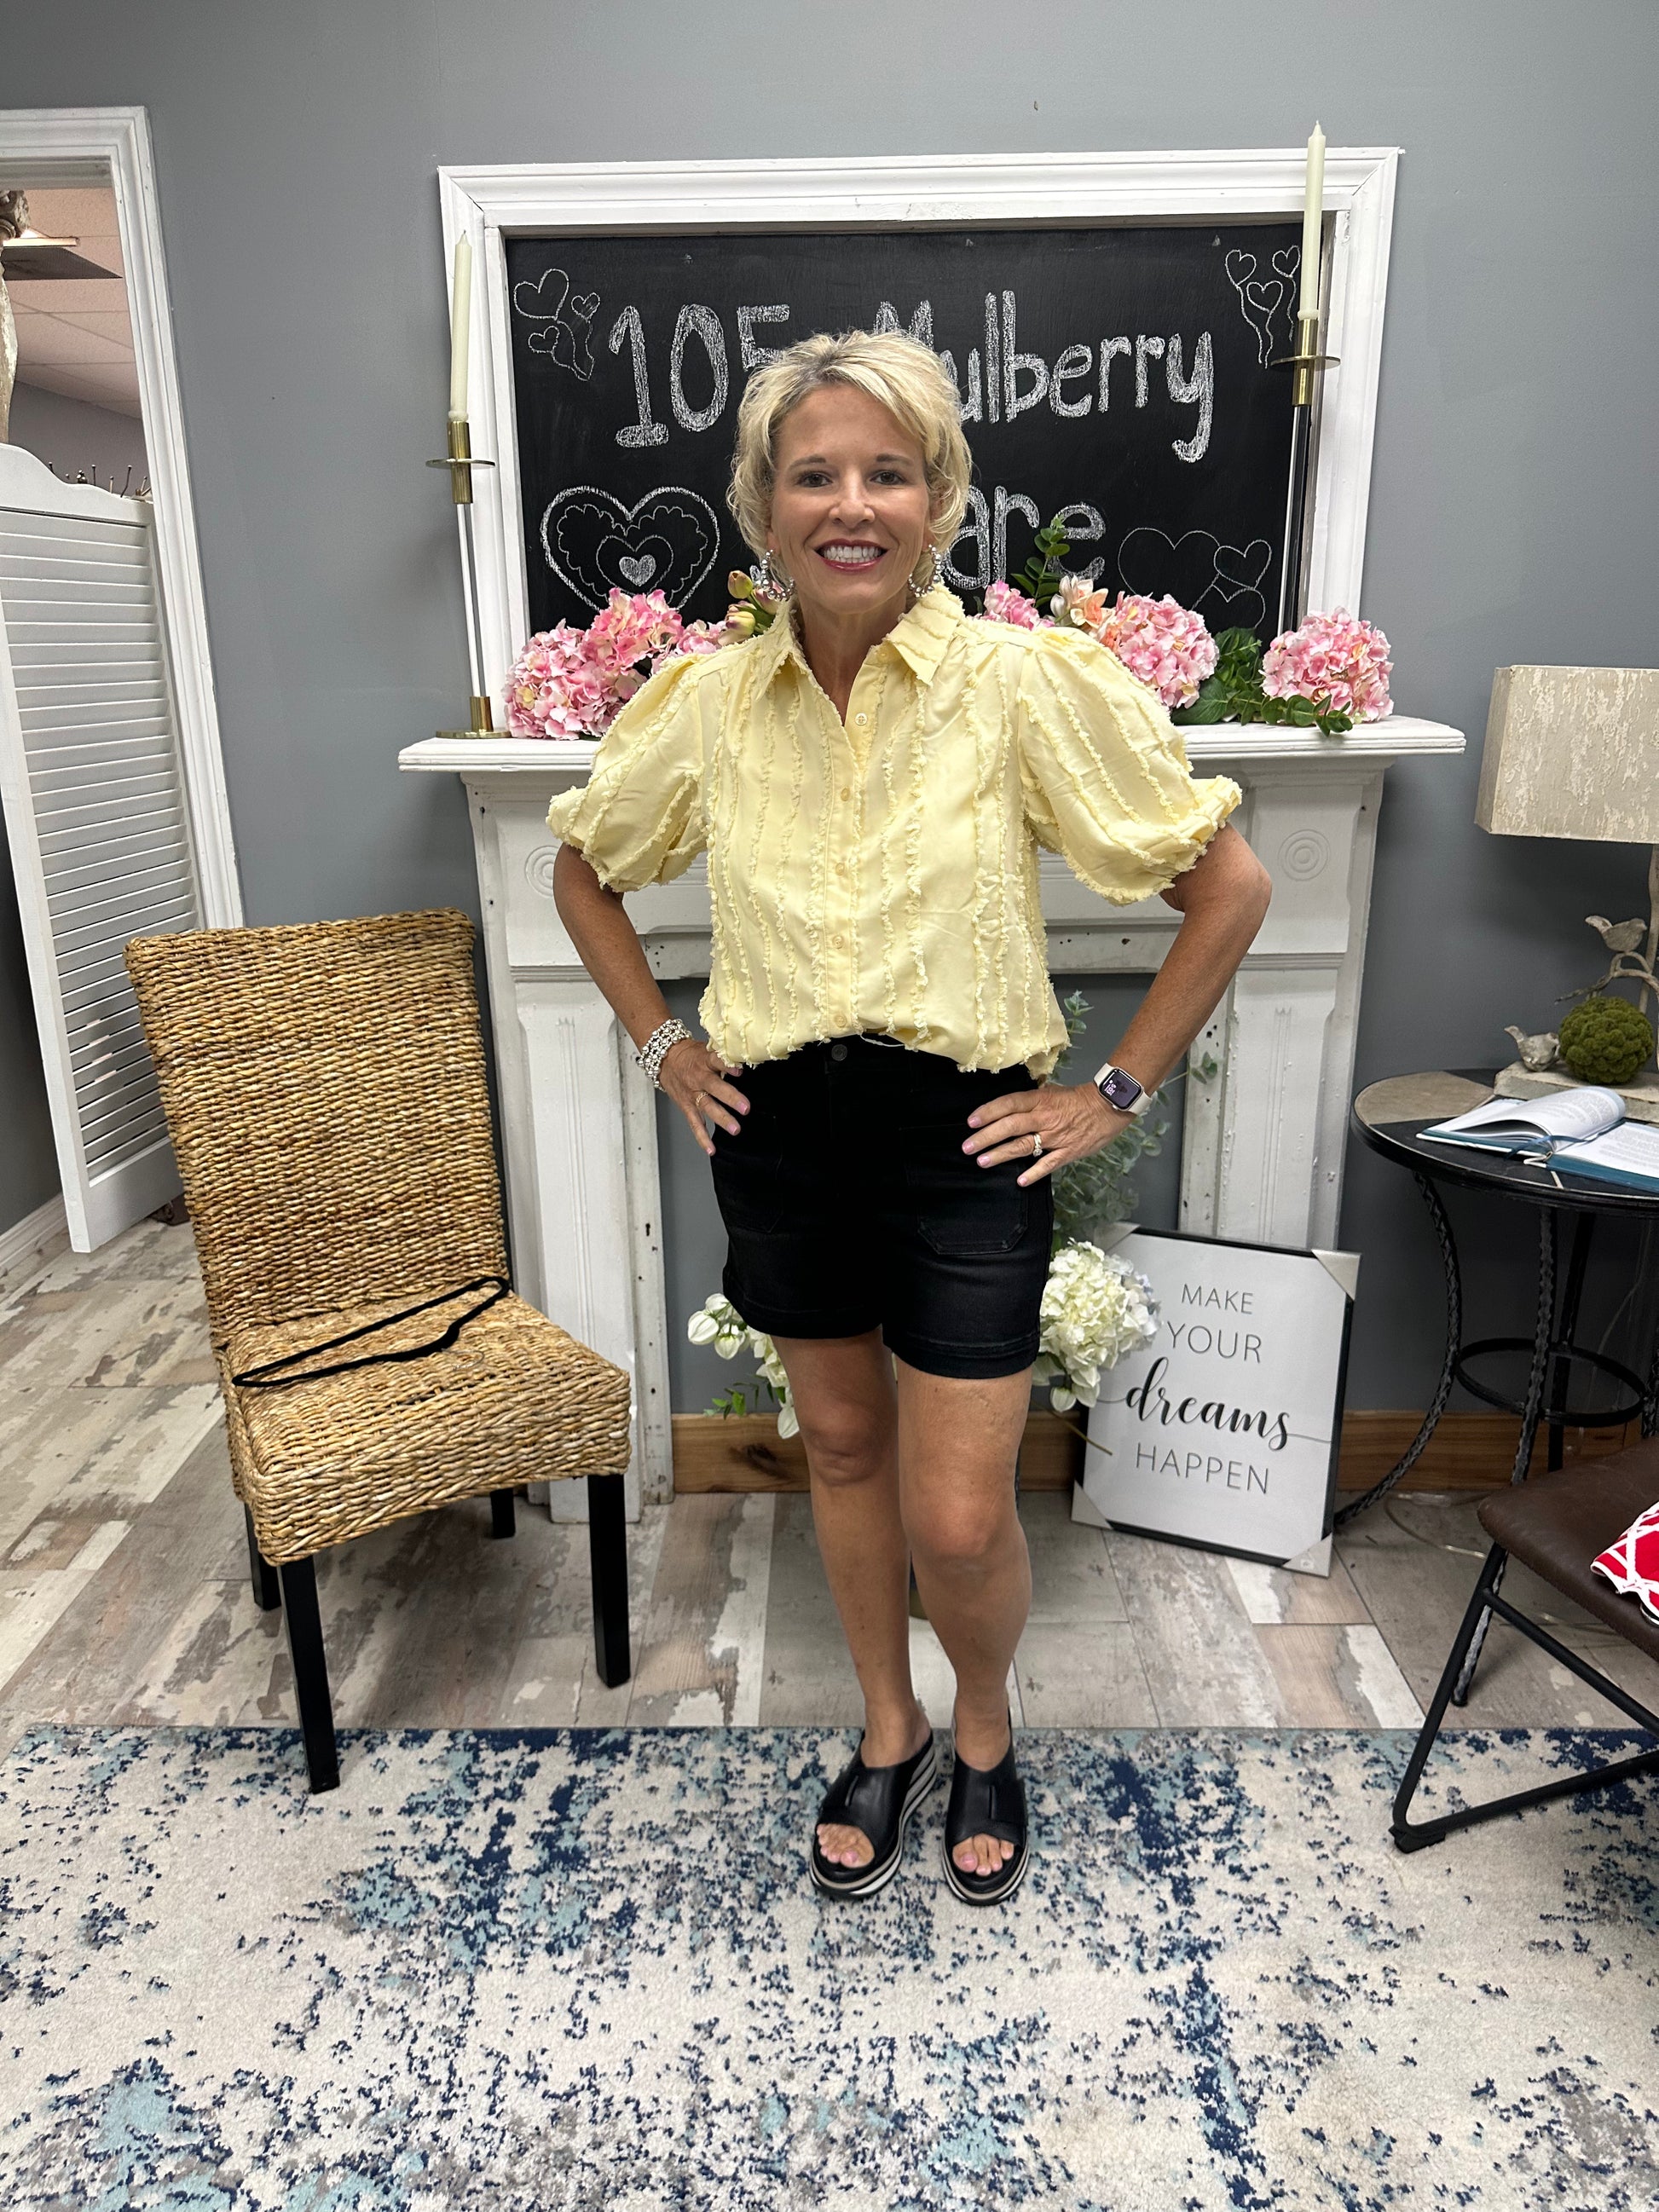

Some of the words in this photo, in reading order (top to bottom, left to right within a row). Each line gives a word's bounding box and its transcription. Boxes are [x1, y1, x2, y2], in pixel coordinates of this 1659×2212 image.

[1182, 1284, 1253, 1314] MAKE
[1167, 1321, 1262, 1363] YOUR
[1125, 1357, 1290, 1451] dreams
[1136, 1442, 1269, 1494] HAPPEN
